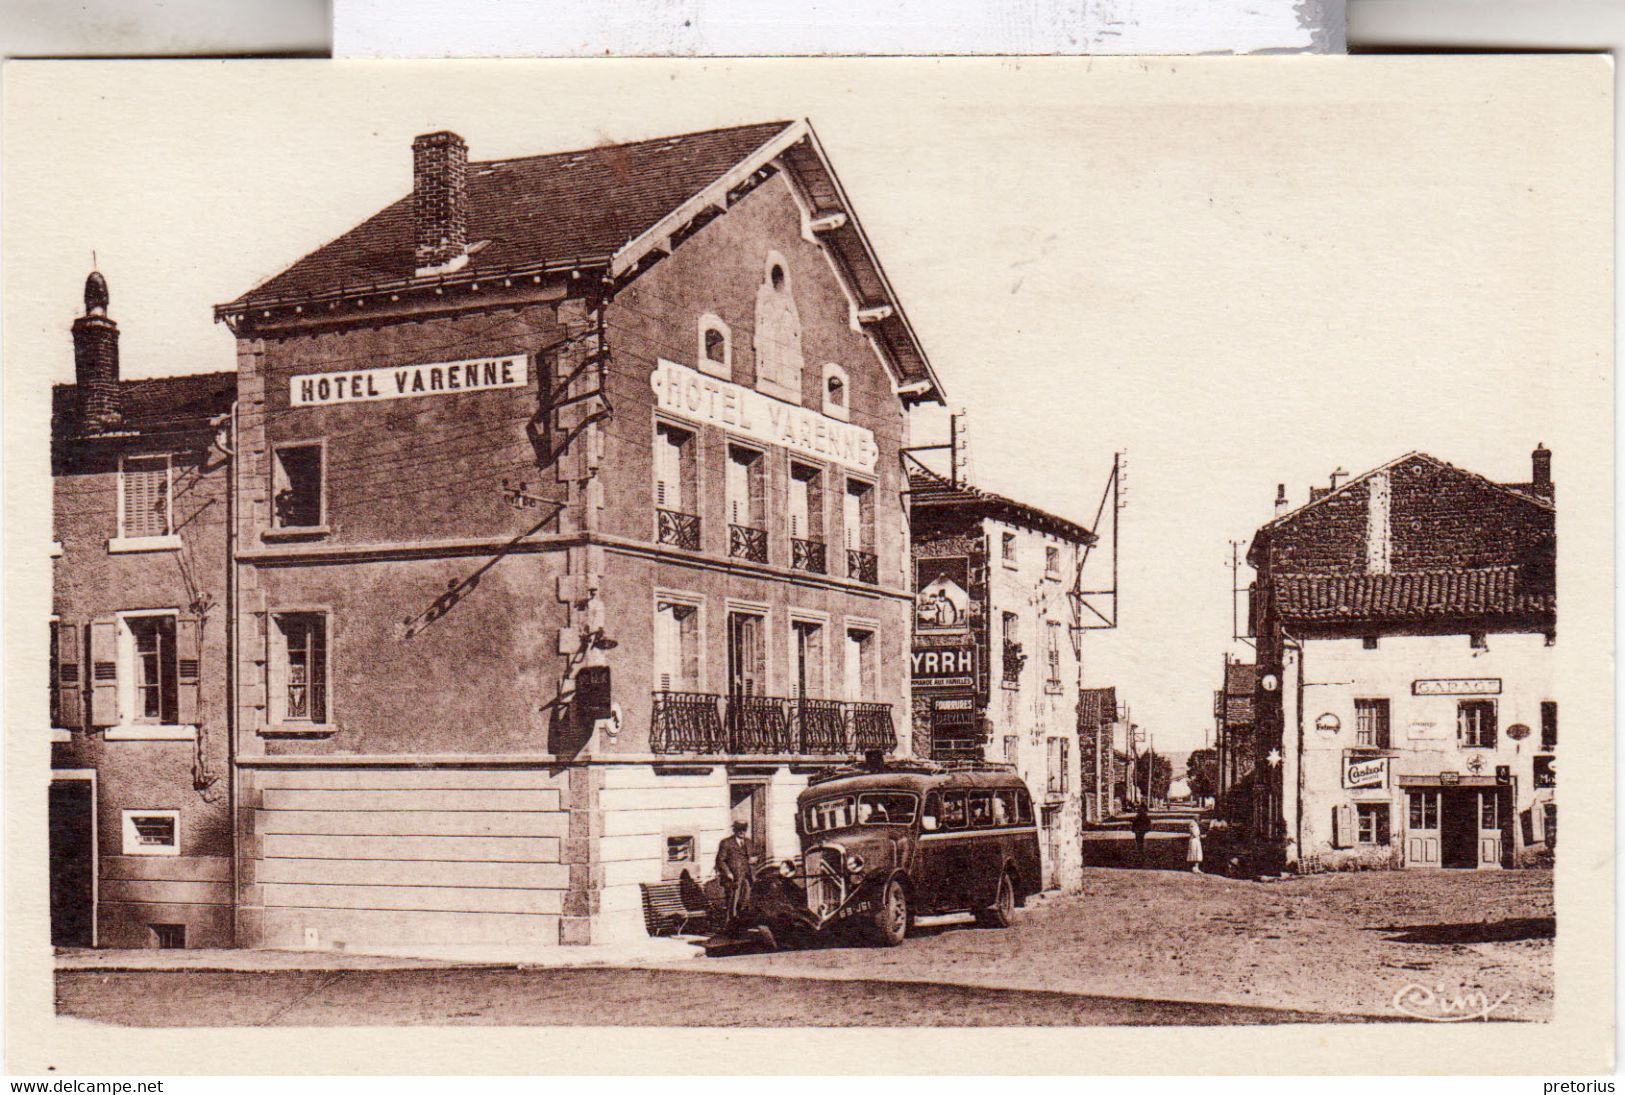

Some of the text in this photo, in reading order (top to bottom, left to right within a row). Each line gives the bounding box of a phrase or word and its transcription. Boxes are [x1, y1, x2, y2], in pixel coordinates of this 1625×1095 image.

[301, 360, 514, 402] HOTEL VARENNE
[666, 366, 869, 466] HOTEL VARENNE
[1348, 761, 1384, 784] Castrol
